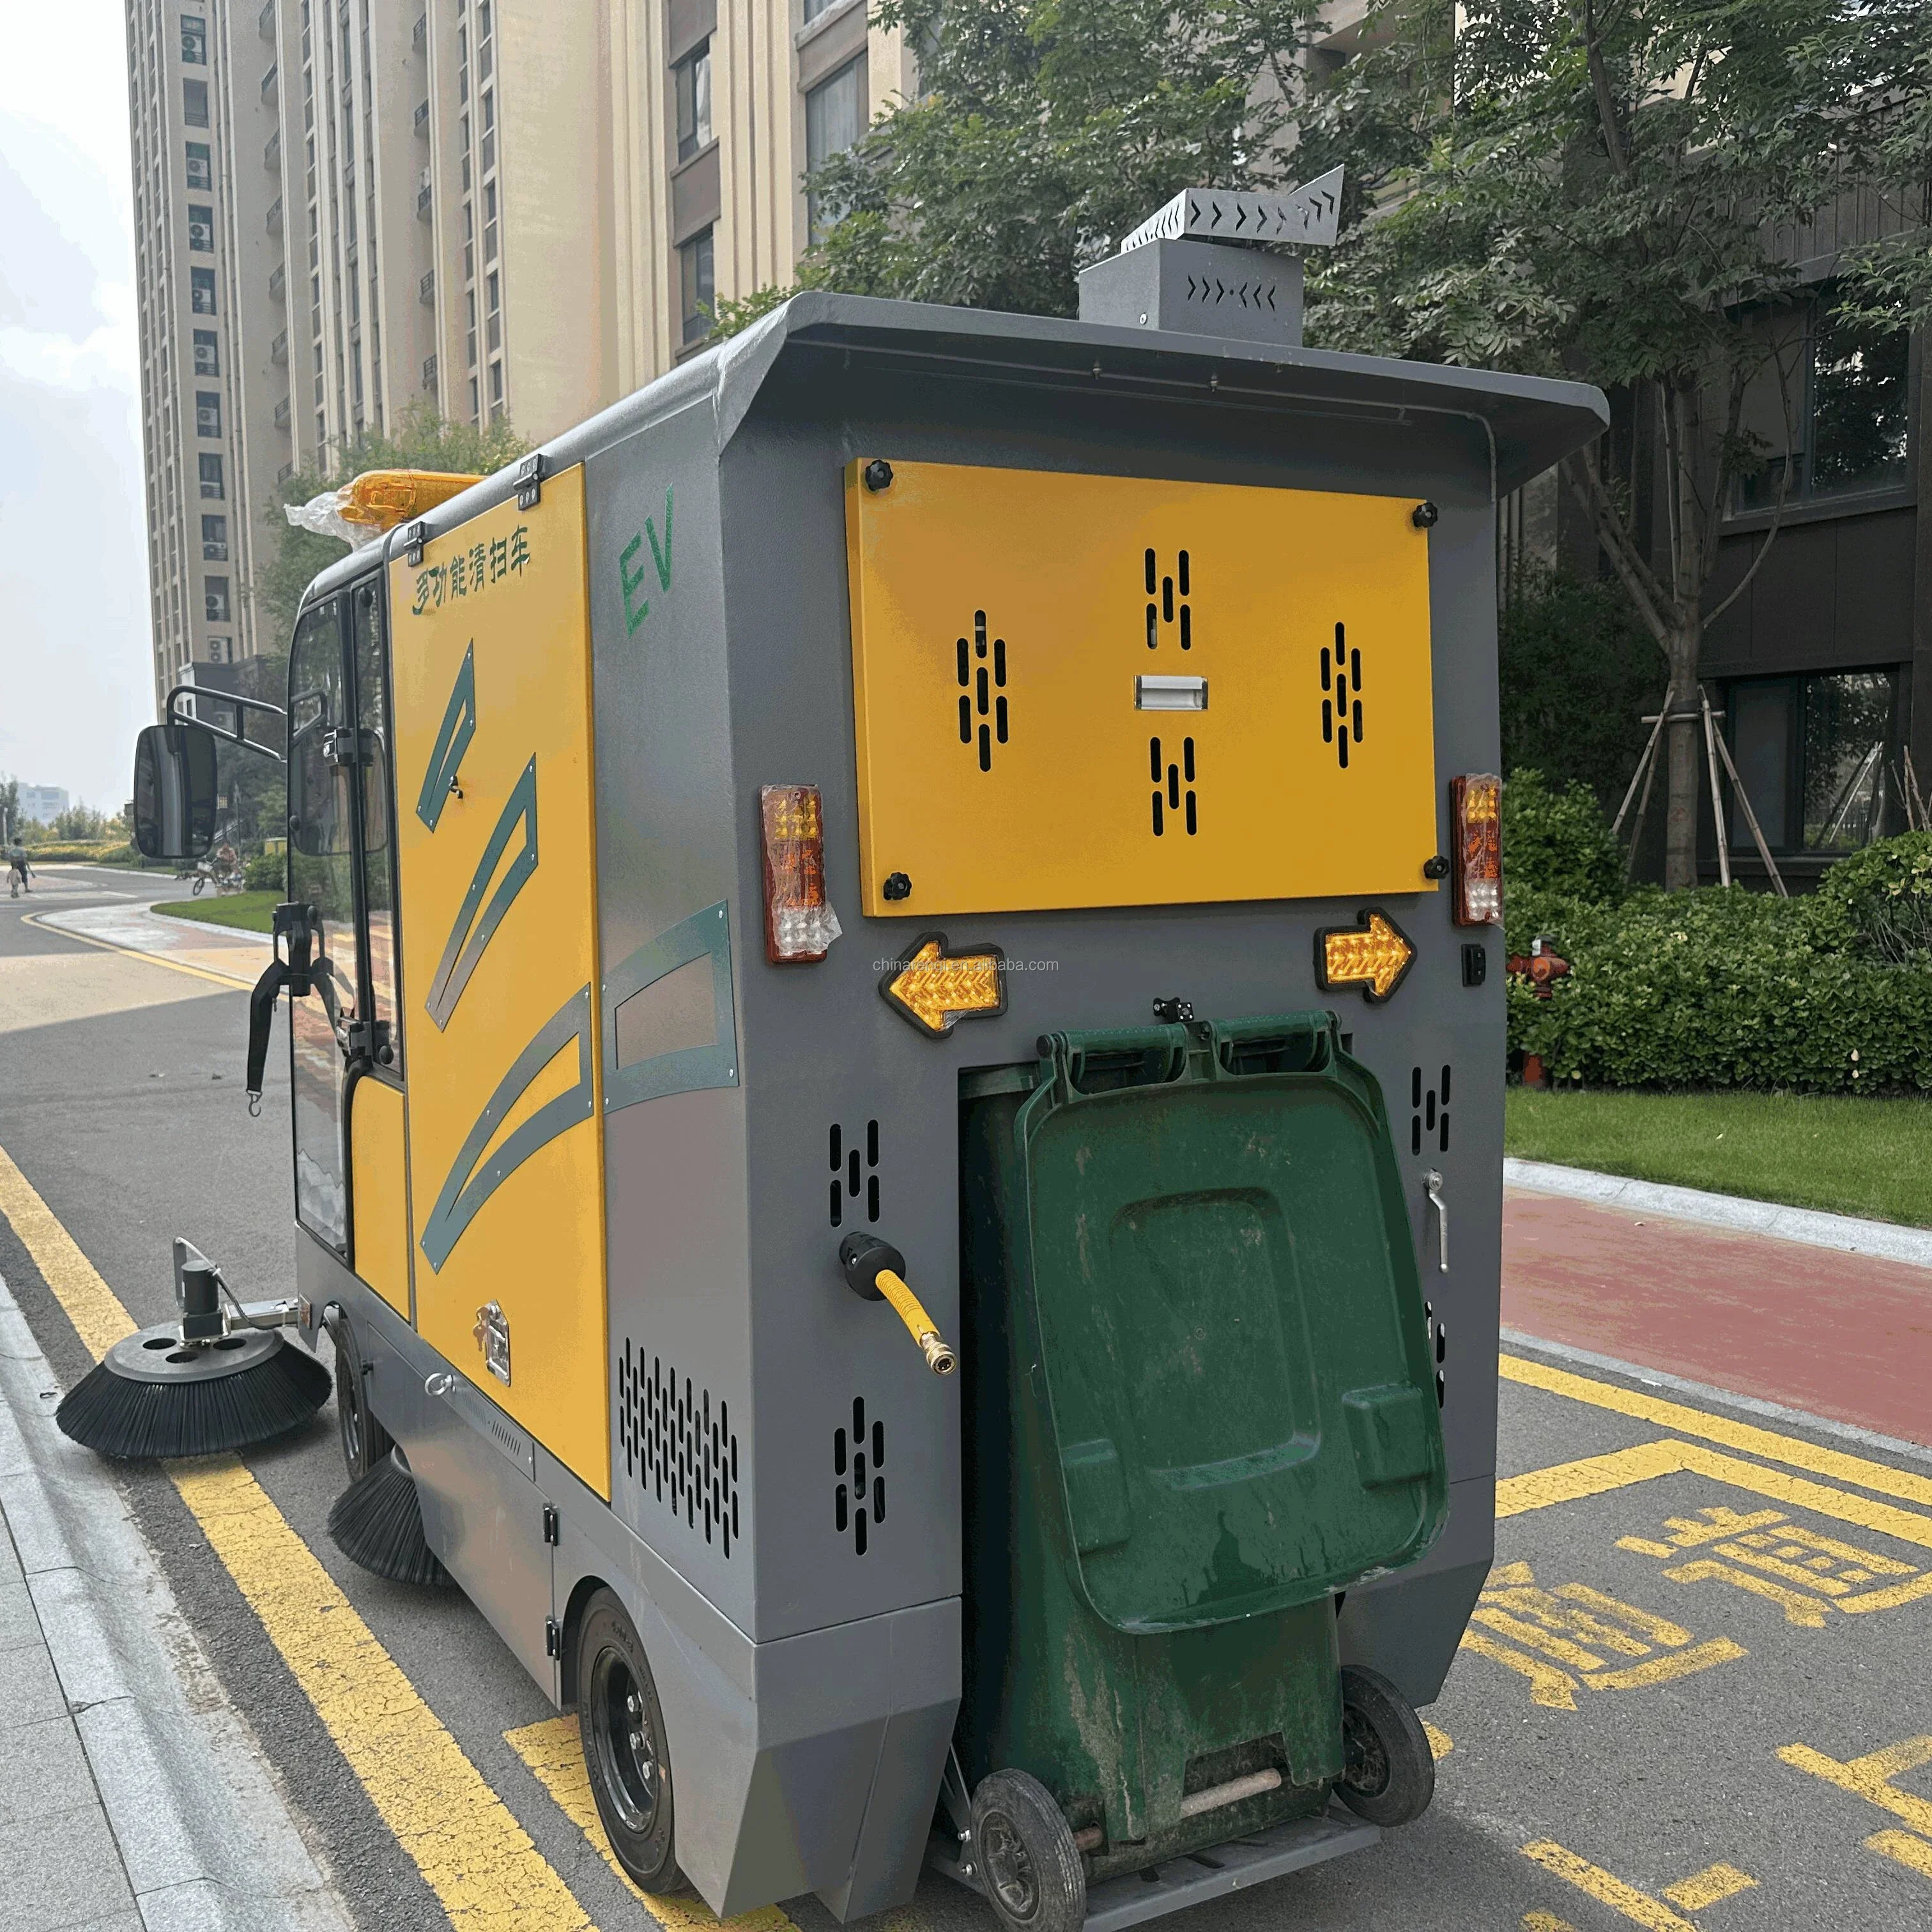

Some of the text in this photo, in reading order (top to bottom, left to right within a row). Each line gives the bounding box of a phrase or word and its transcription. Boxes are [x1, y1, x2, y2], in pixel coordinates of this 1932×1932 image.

[412, 524, 530, 616] 多功能清扫车
[619, 482, 673, 639] EV
